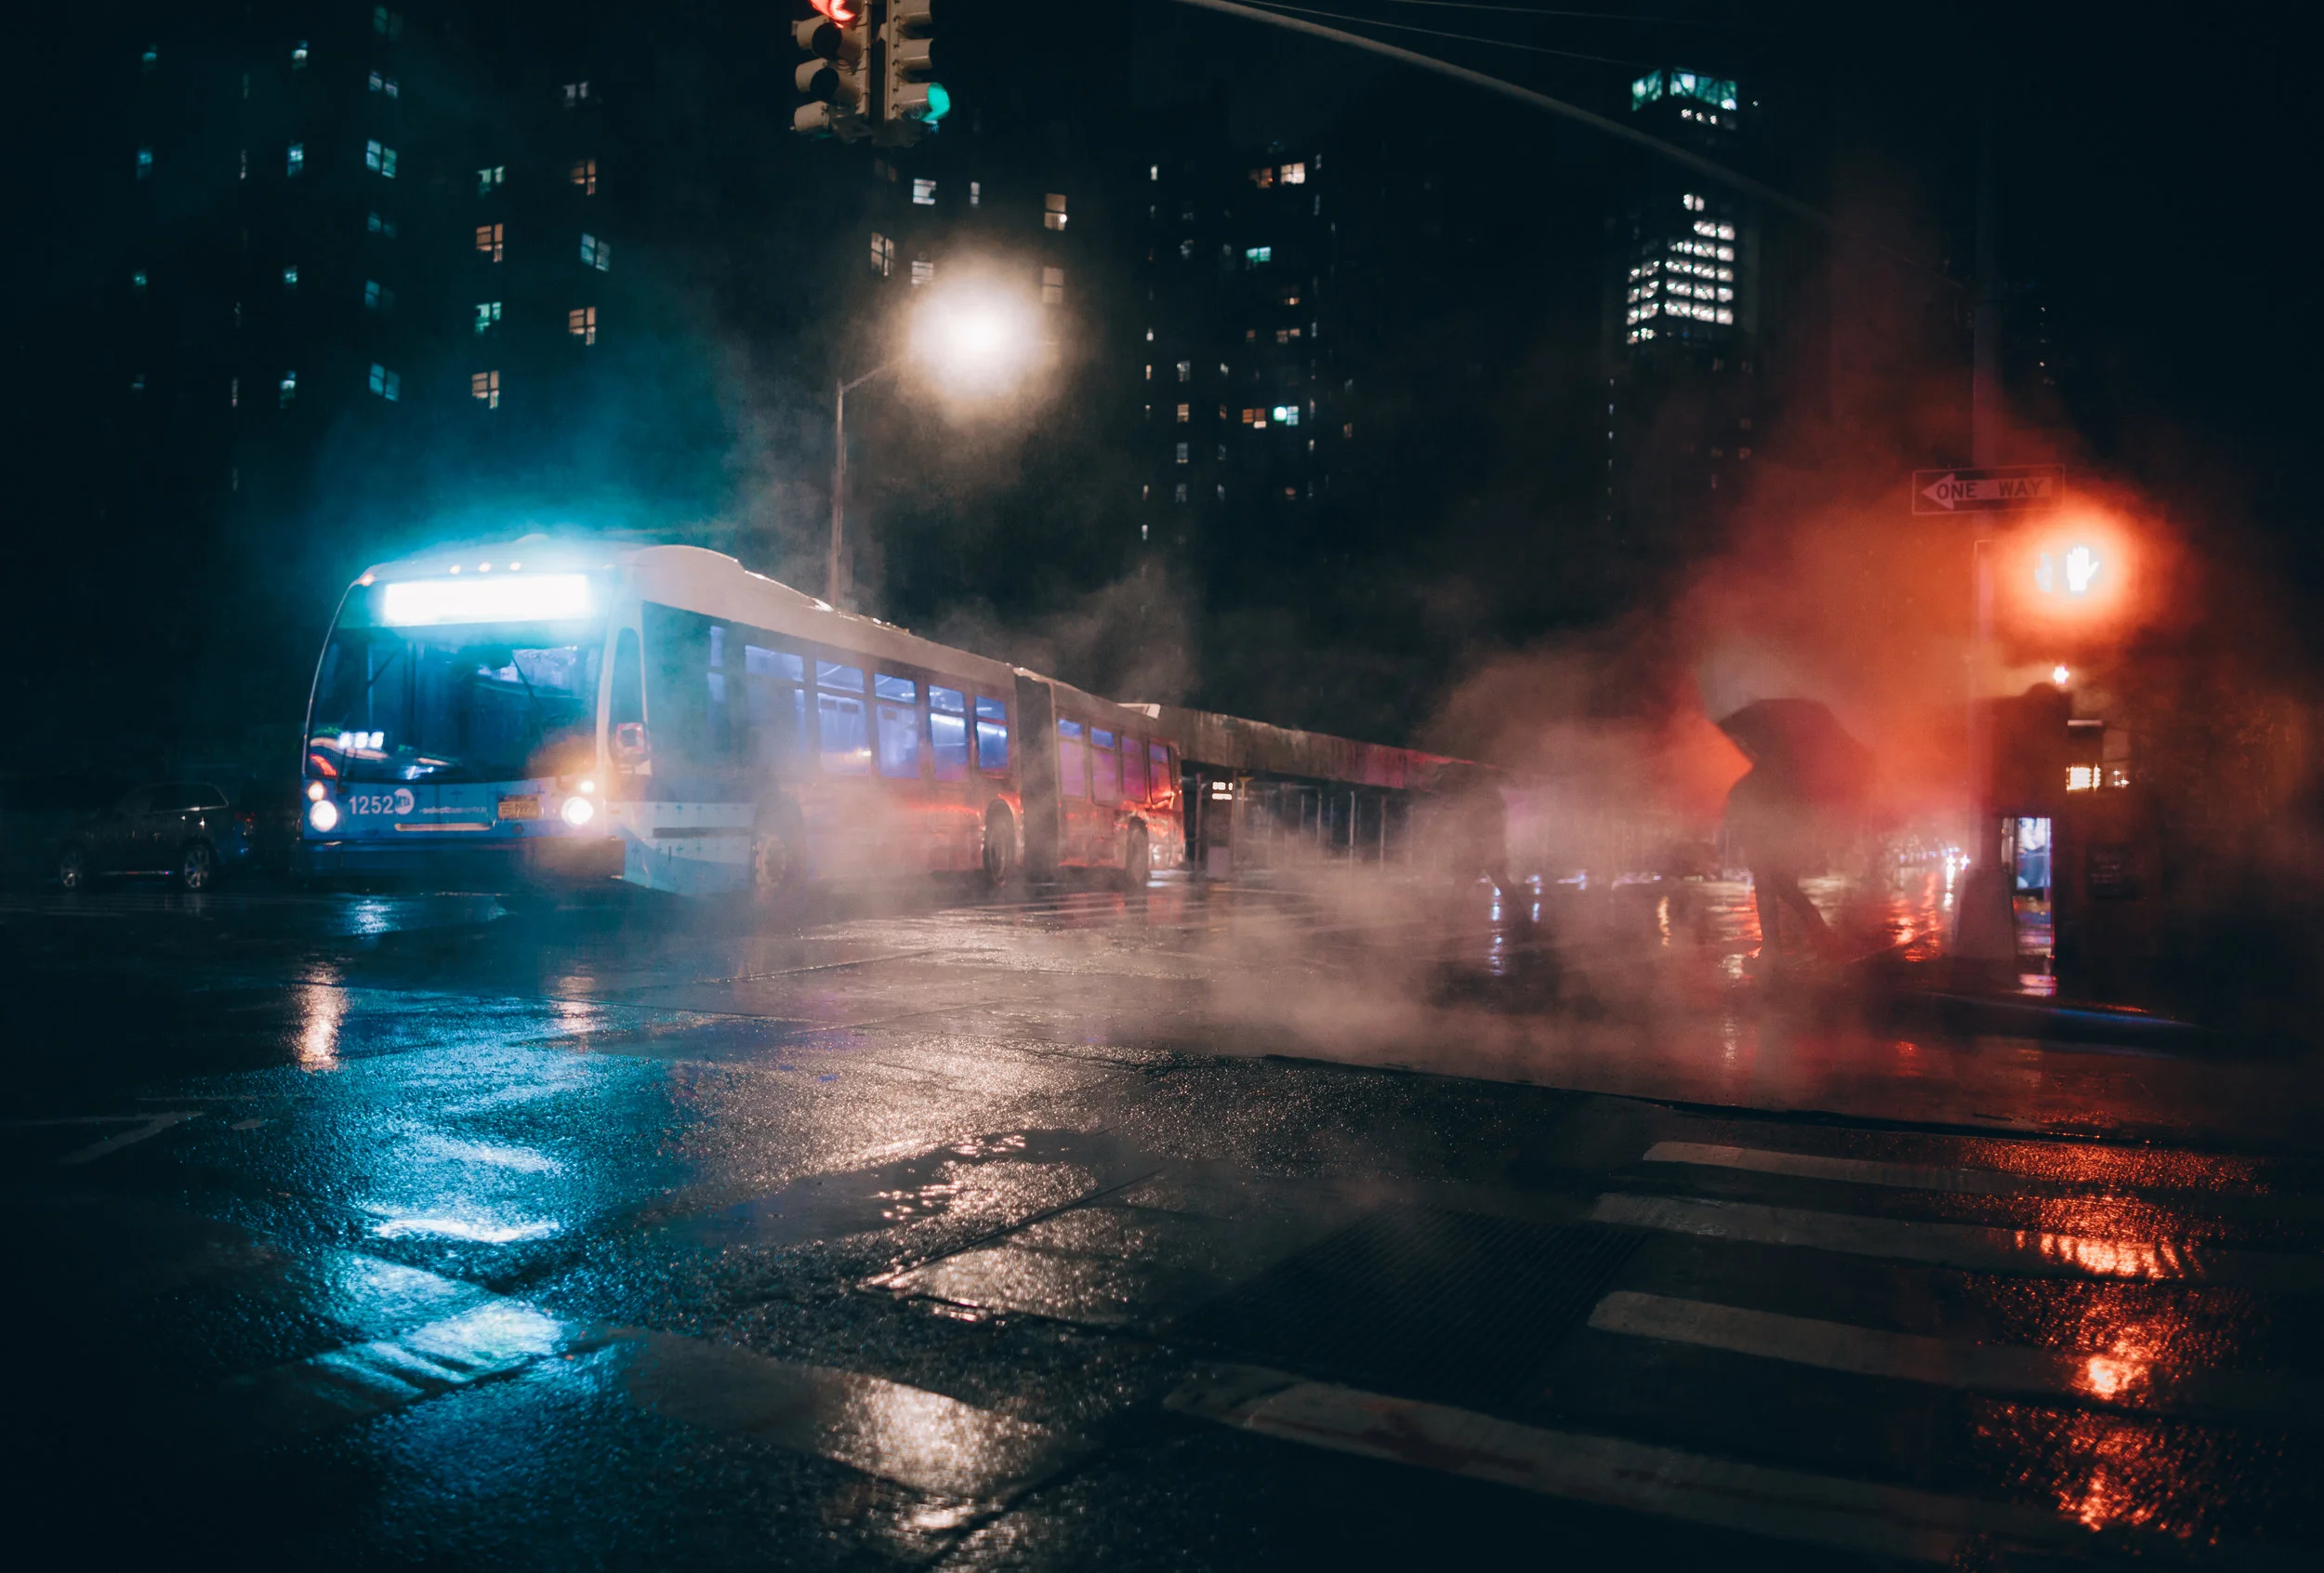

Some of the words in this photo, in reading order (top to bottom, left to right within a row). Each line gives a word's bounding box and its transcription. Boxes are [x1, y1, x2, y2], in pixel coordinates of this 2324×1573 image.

[1936, 482, 1977, 499] ONE
[1999, 479, 2043, 497] WAY
[349, 796, 393, 814] 1252
